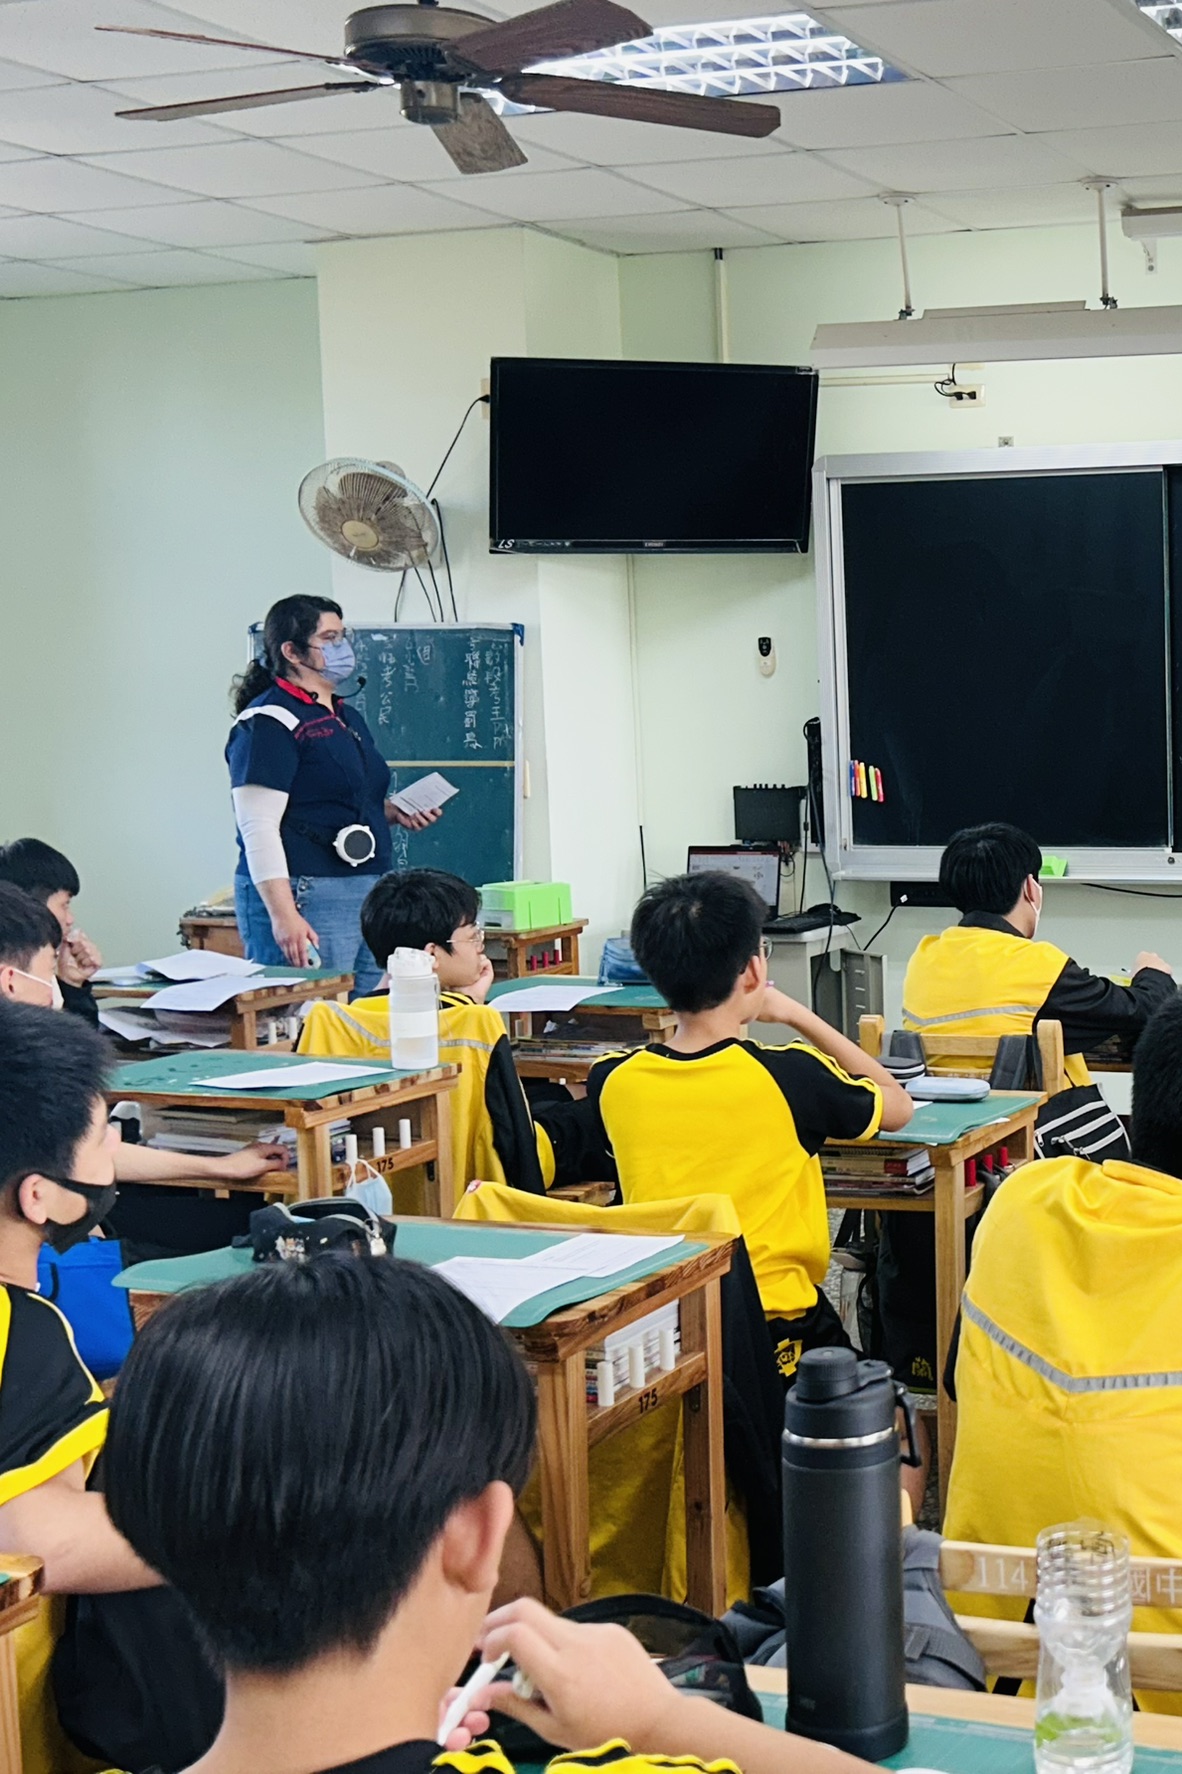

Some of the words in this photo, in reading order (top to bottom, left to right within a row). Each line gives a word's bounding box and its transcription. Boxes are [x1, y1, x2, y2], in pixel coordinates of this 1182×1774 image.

[376, 1157, 394, 1173] 175
[638, 1387, 658, 1414] 175
[977, 1555, 1029, 1593] 114
